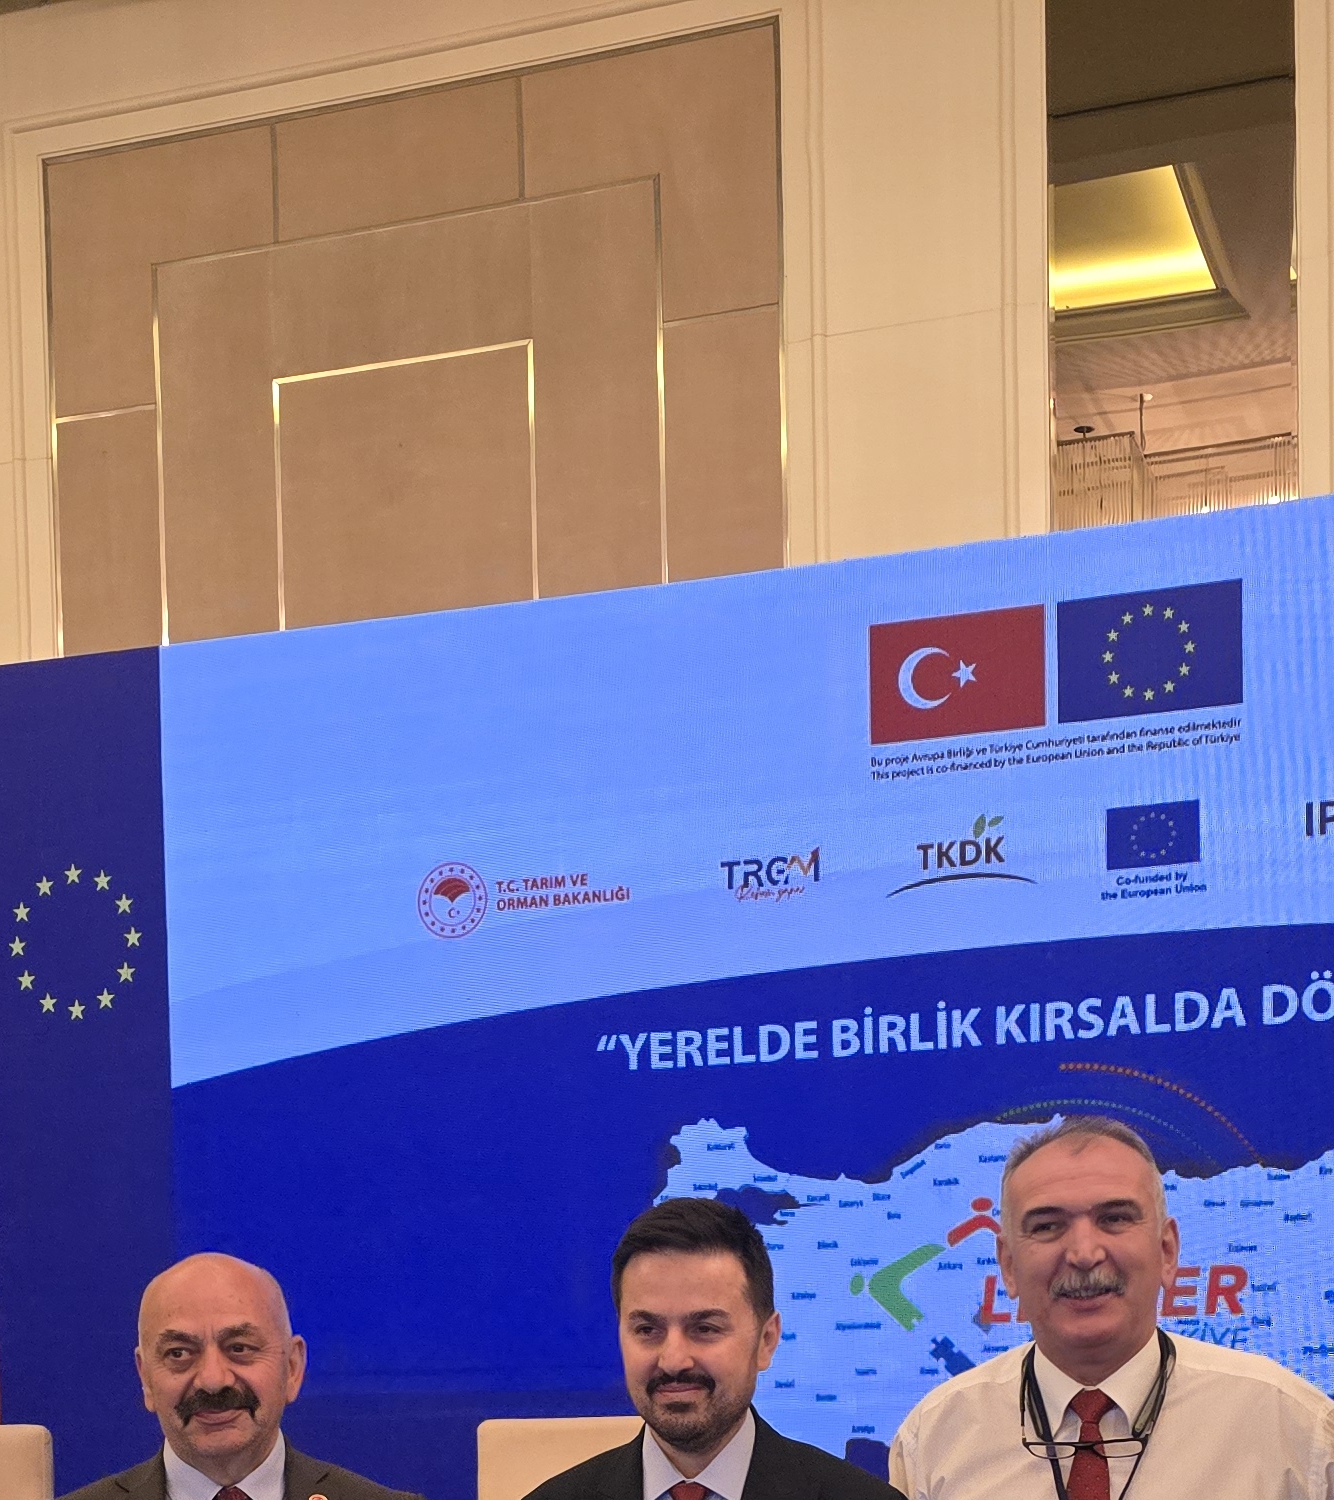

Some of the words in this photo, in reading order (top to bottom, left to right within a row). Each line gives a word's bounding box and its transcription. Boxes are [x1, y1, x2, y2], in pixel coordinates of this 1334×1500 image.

[891, 764, 925, 781] project
[936, 757, 993, 774] co-financed
[994, 757, 1006, 768] by
[1008, 756, 1024, 766] the
[1026, 750, 1072, 764] European
[1075, 747, 1104, 759] Union
[1106, 743, 1126, 756] and
[1127, 742, 1144, 753] the
[1146, 735, 1190, 751] Republic
[1192, 734, 1203, 746] of
[976, 747, 988, 756] ve
[916, 835, 1005, 870] TKDK
[720, 846, 820, 889] TRGM
[1116, 871, 1172, 886] Co-funded
[1175, 871, 1188, 882] by
[496, 880, 519, 893] T.C.
[522, 875, 566, 891] TARIM
[570, 873, 588, 887] VE
[1100, 891, 1118, 900] the
[1120, 886, 1172, 899] European
[1175, 882, 1207, 894] Union
[496, 894, 549, 911] ORMAN
[553, 886, 630, 906] BAKANLIĞI
[833, 997, 981, 1060] BİRLİK
[995, 989, 1246, 1046] KIRSALDA
